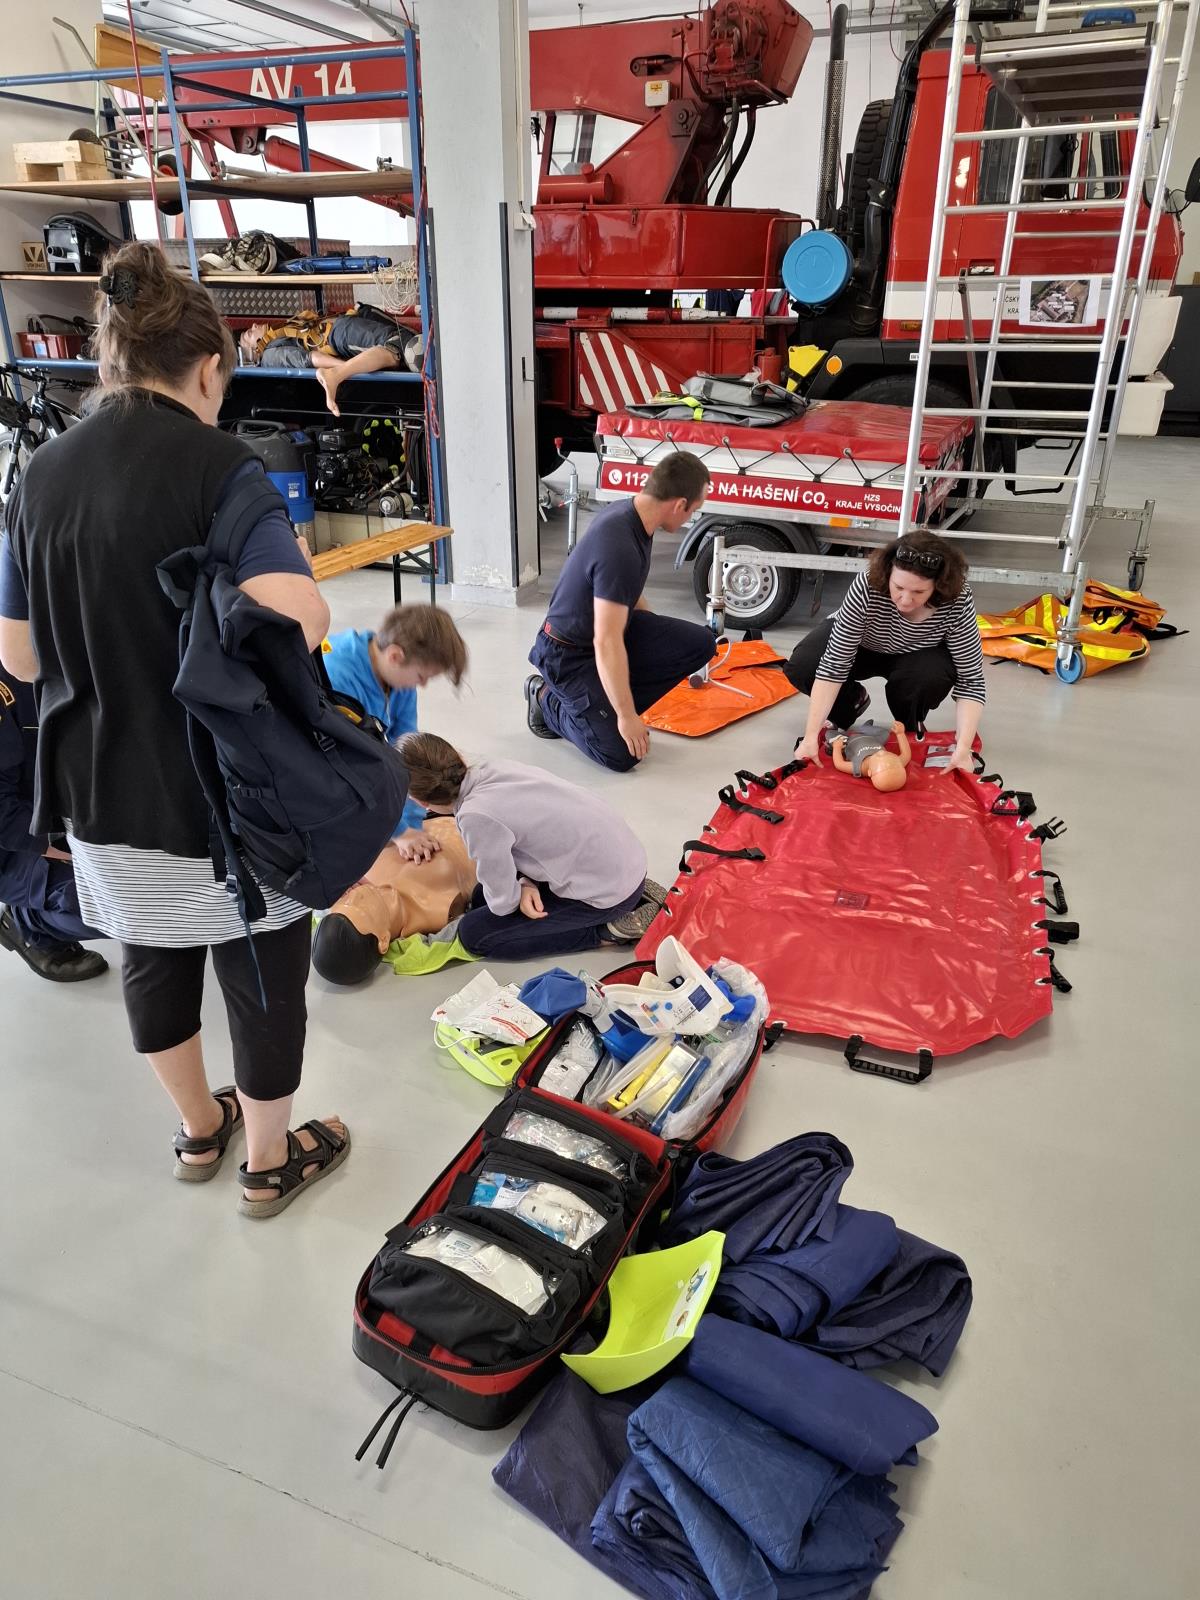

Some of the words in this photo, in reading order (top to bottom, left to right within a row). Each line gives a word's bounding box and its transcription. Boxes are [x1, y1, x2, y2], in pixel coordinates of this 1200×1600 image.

[249, 64, 294, 101] AV
[313, 61, 357, 97] 14
[624, 471, 649, 487] 112
[718, 481, 739, 497] NA
[742, 483, 800, 503] HAŠENÍ
[863, 493, 881, 502] HZS
[835, 500, 863, 510] KRAJE
[864, 503, 901, 514] VYSOČIN
